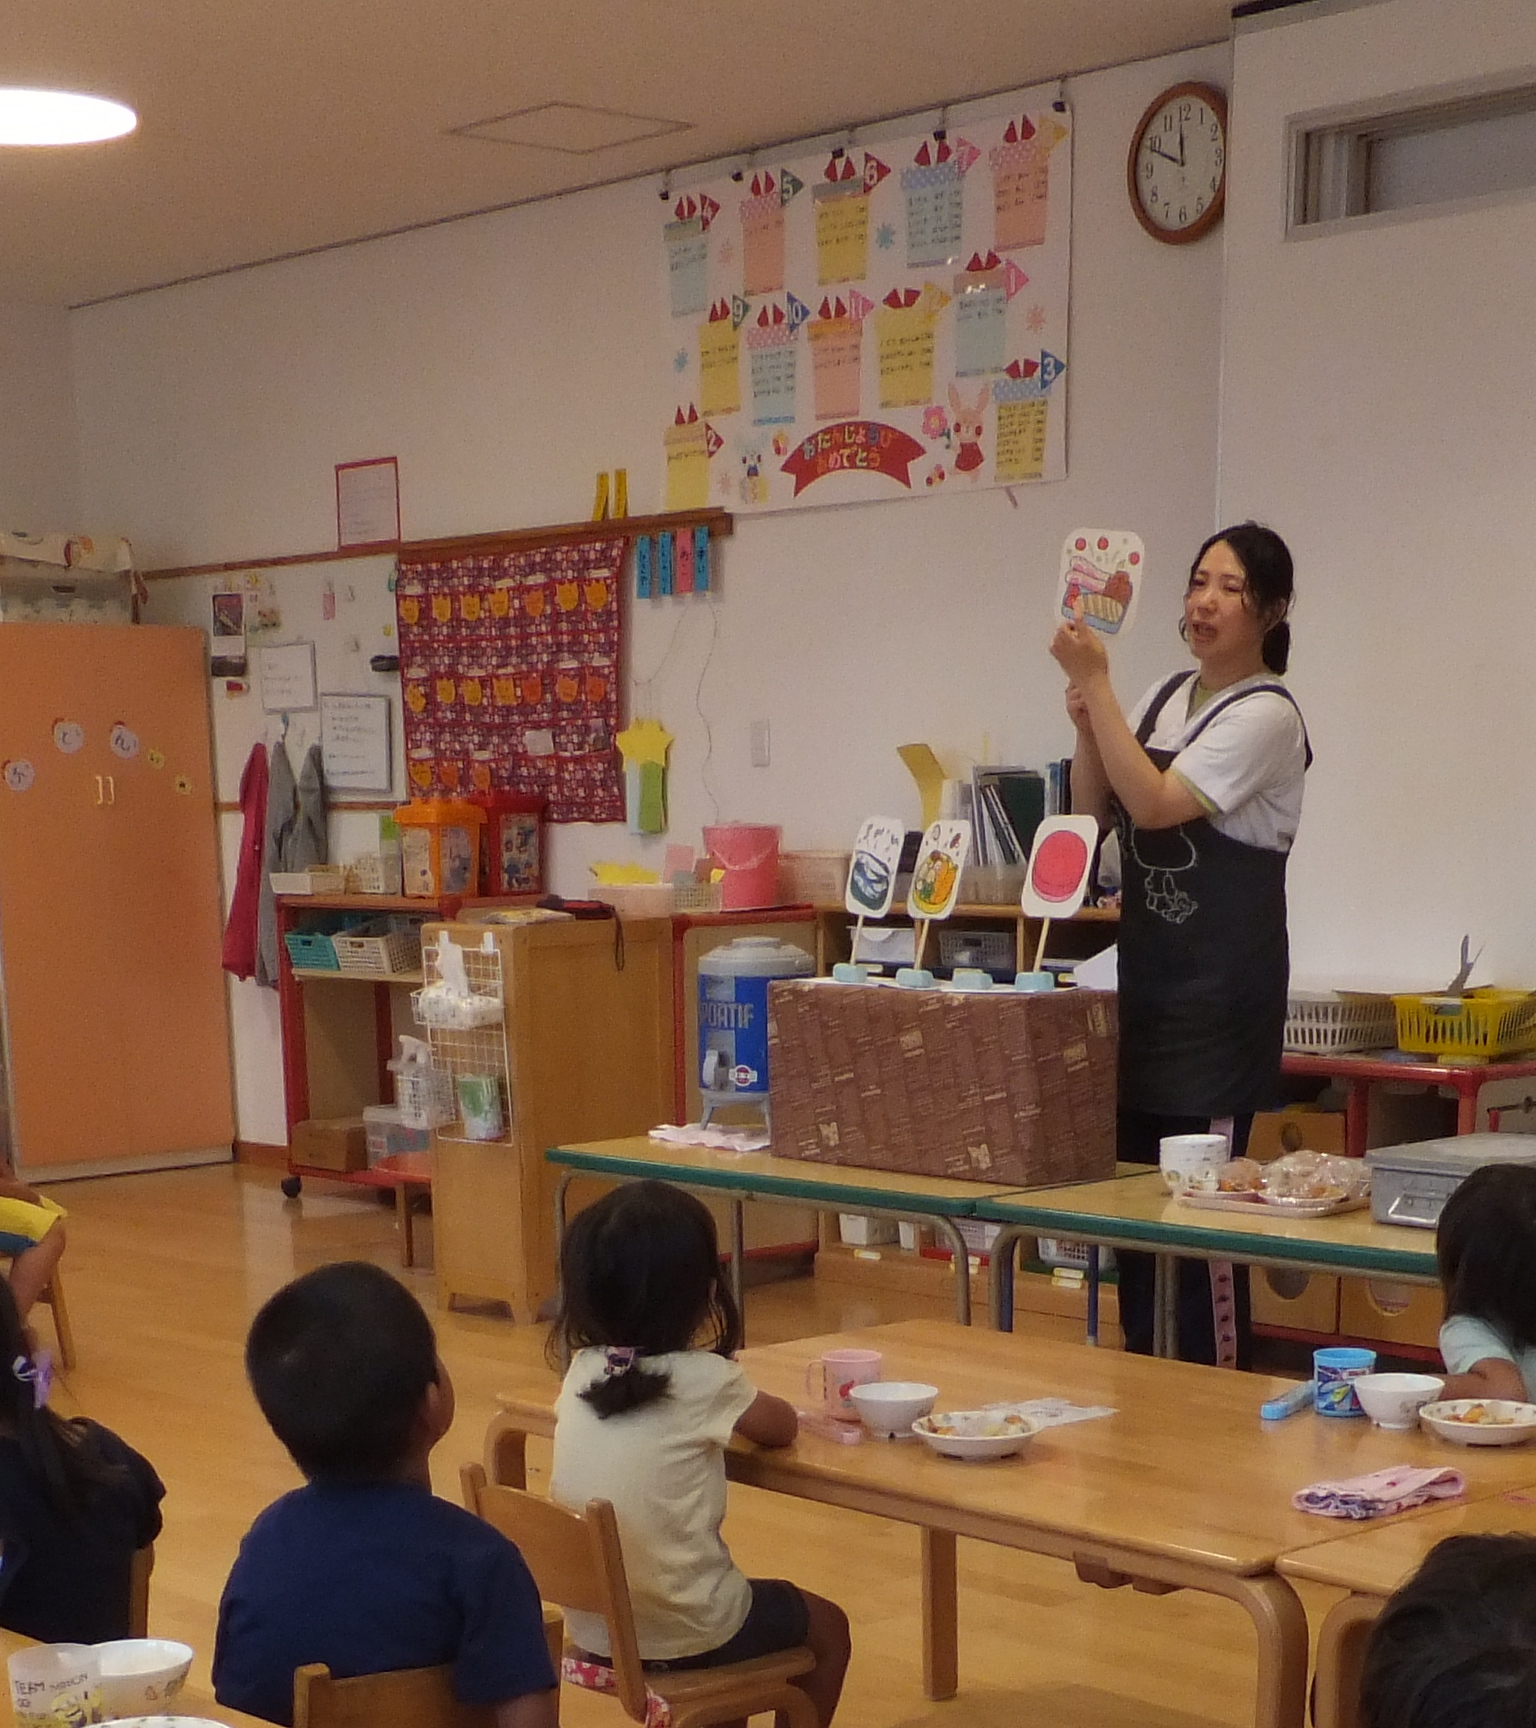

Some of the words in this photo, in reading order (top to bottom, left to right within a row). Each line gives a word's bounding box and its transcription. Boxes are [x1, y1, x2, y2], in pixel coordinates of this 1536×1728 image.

[1179, 103, 1192, 122] 12
[1199, 107, 1204, 125] 1
[1163, 114, 1173, 132] 11
[1210, 123, 1219, 141] 2
[1148, 135, 1162, 151] 10
[1214, 148, 1222, 167] 3
[865, 159, 878, 185] 6
[1145, 163, 1154, 179] 9
[783, 176, 794, 198] 5
[1210, 176, 1217, 192] 4
[1150, 185, 1159, 203] 8
[1163, 202, 1170, 219] 7
[1179, 206, 1187, 223] 6
[1196, 197, 1204, 214] 5
[733, 300, 743, 321] 9
[787, 302, 802, 324] 10
[1043, 357, 1056, 381] 3
[707, 429, 717, 451] 2
